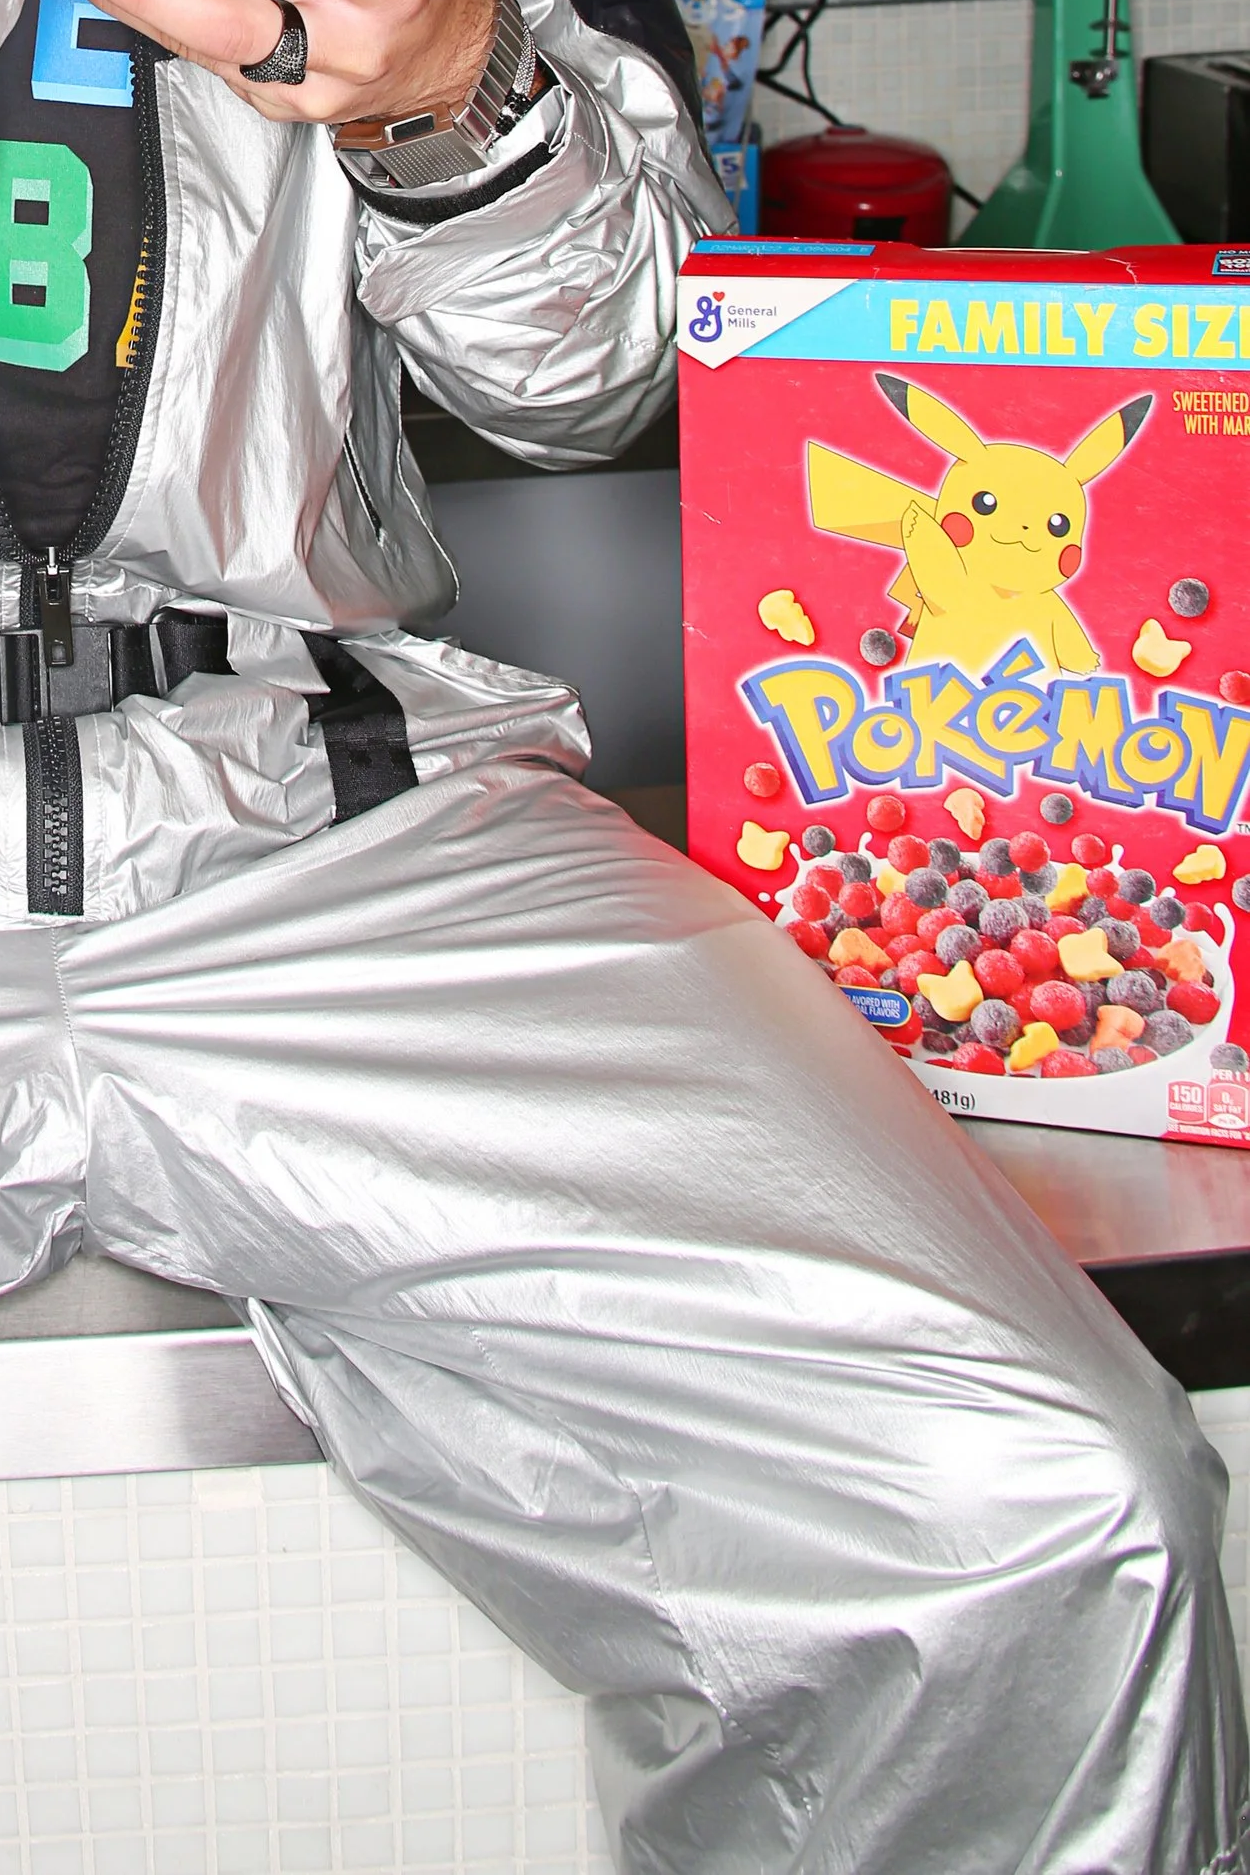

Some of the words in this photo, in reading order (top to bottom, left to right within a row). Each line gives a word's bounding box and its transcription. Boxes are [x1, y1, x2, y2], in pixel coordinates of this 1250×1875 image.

[727, 305, 778, 318] General
[727, 318, 757, 329] Mills
[890, 298, 1118, 357] FAMILY
[1172, 390, 1249, 414] SWEETENED
[1184, 413, 1219, 436] WITH
[881, 997, 900, 1009] WITH
[869, 1007, 901, 1019] FLAVORS
[1212, 1068, 1233, 1082] PER
[1171, 1085, 1202, 1105] 150
[1170, 1102, 1204, 1114] CALORIES
[1213, 1103, 1227, 1114] SAT
[1228, 1104, 1243, 1114] FAT
